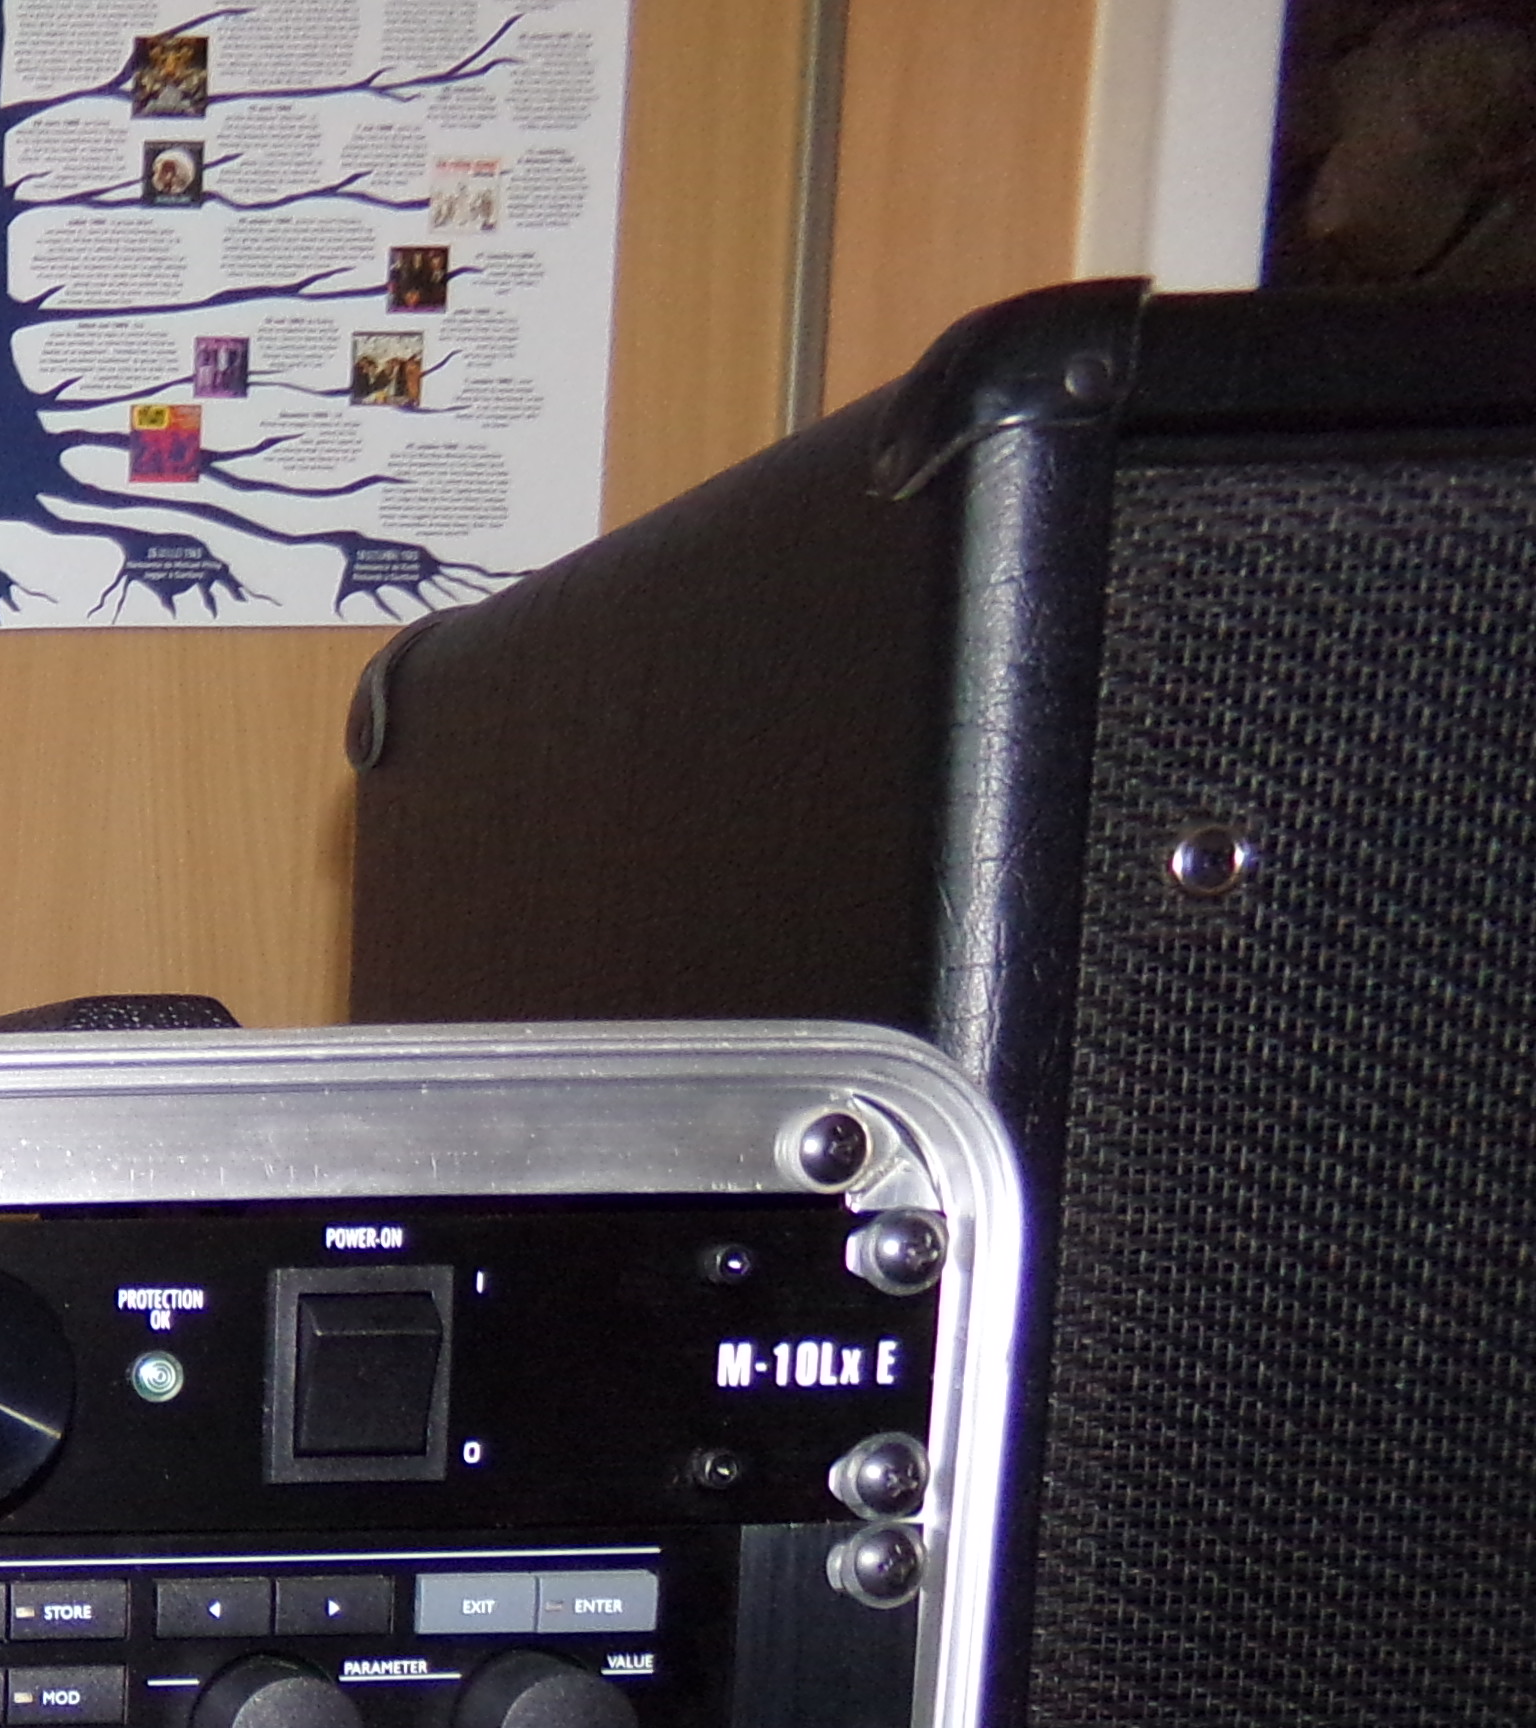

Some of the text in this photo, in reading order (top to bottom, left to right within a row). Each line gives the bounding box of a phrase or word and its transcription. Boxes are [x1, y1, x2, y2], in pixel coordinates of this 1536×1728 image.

[325, 1226, 403, 1249] POWER-ON
[117, 1288, 205, 1310] PROTECTION
[149, 1311, 171, 1331] OK
[716, 1339, 898, 1387] M-10Lx E
[44, 1605, 92, 1620] STORE
[462, 1599, 495, 1615] EXIT
[574, 1599, 623, 1614] ENTER
[343, 1659, 428, 1676] PARAMETER
[607, 1653, 654, 1670] VALUE
[42, 1690, 80, 1705] MOD
